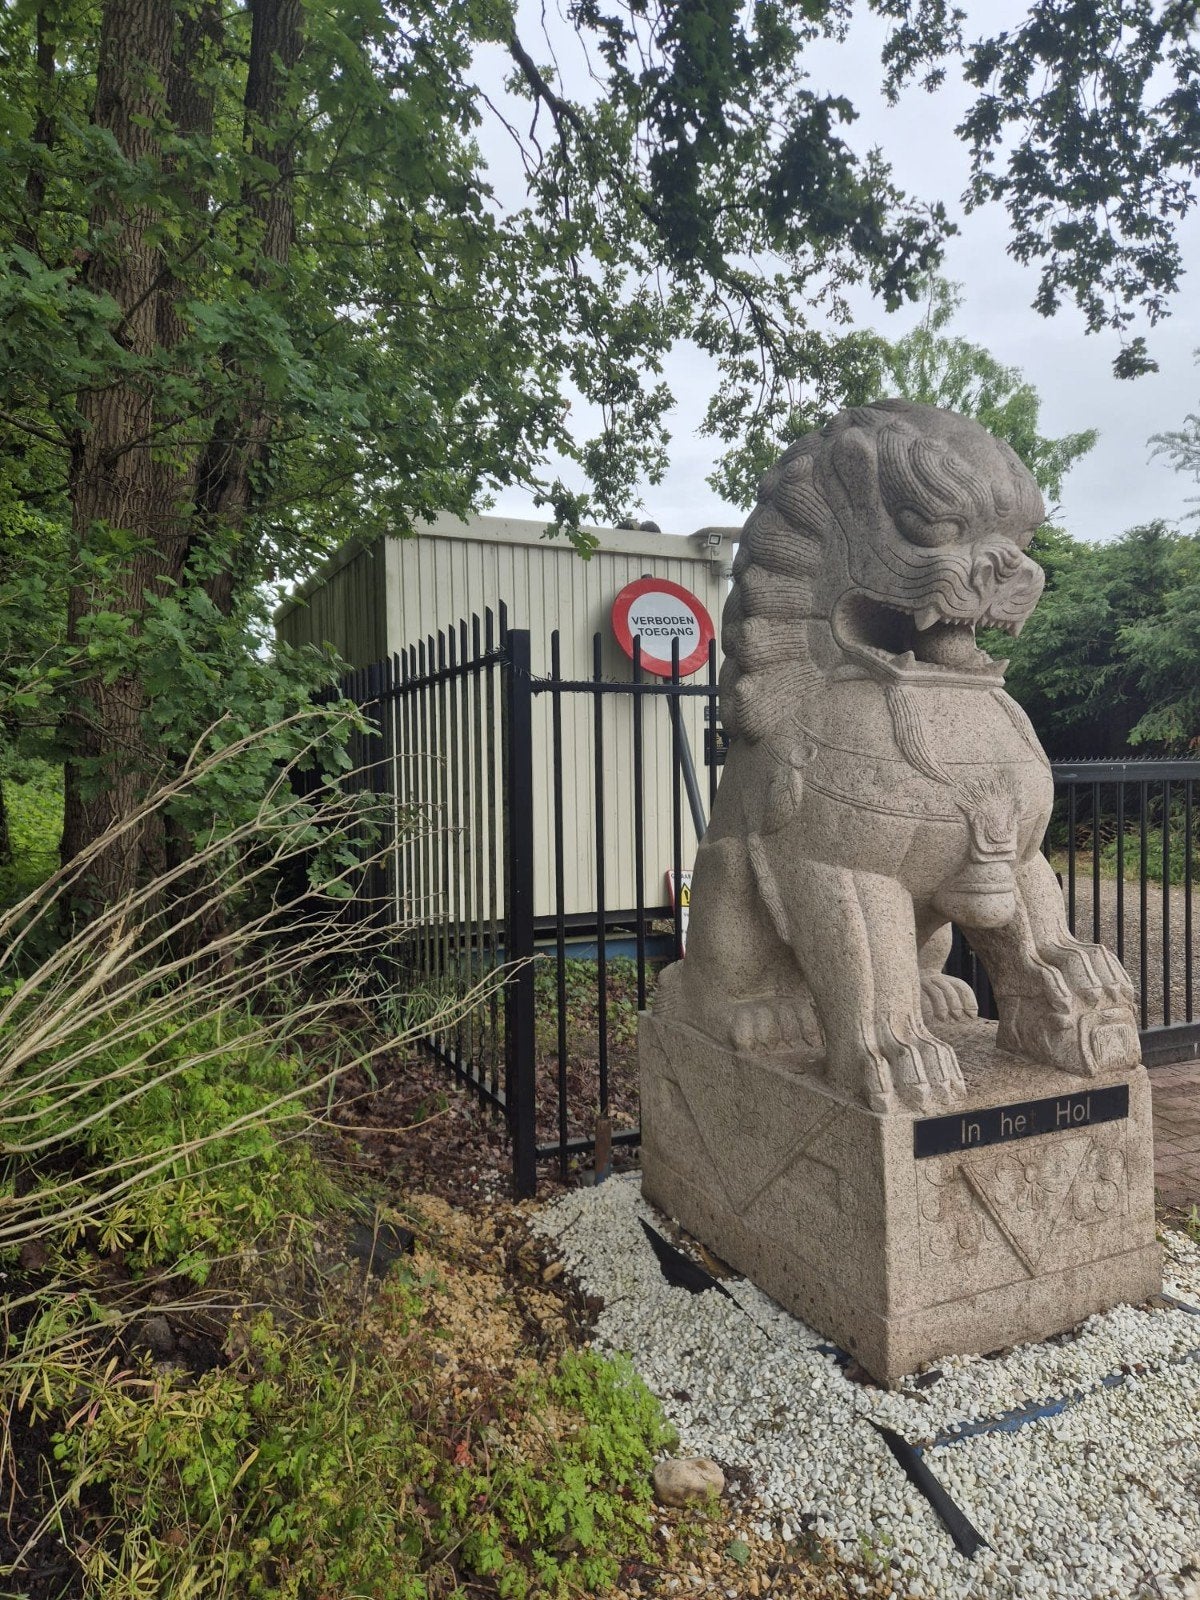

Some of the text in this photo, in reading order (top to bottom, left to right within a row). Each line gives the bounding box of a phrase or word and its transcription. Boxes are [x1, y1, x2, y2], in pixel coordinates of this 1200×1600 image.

[631, 616, 694, 625] VERBODEN
[638, 627, 694, 636] TOEGANG
[961, 1119, 981, 1144] In
[1056, 1097, 1091, 1125] Hol
